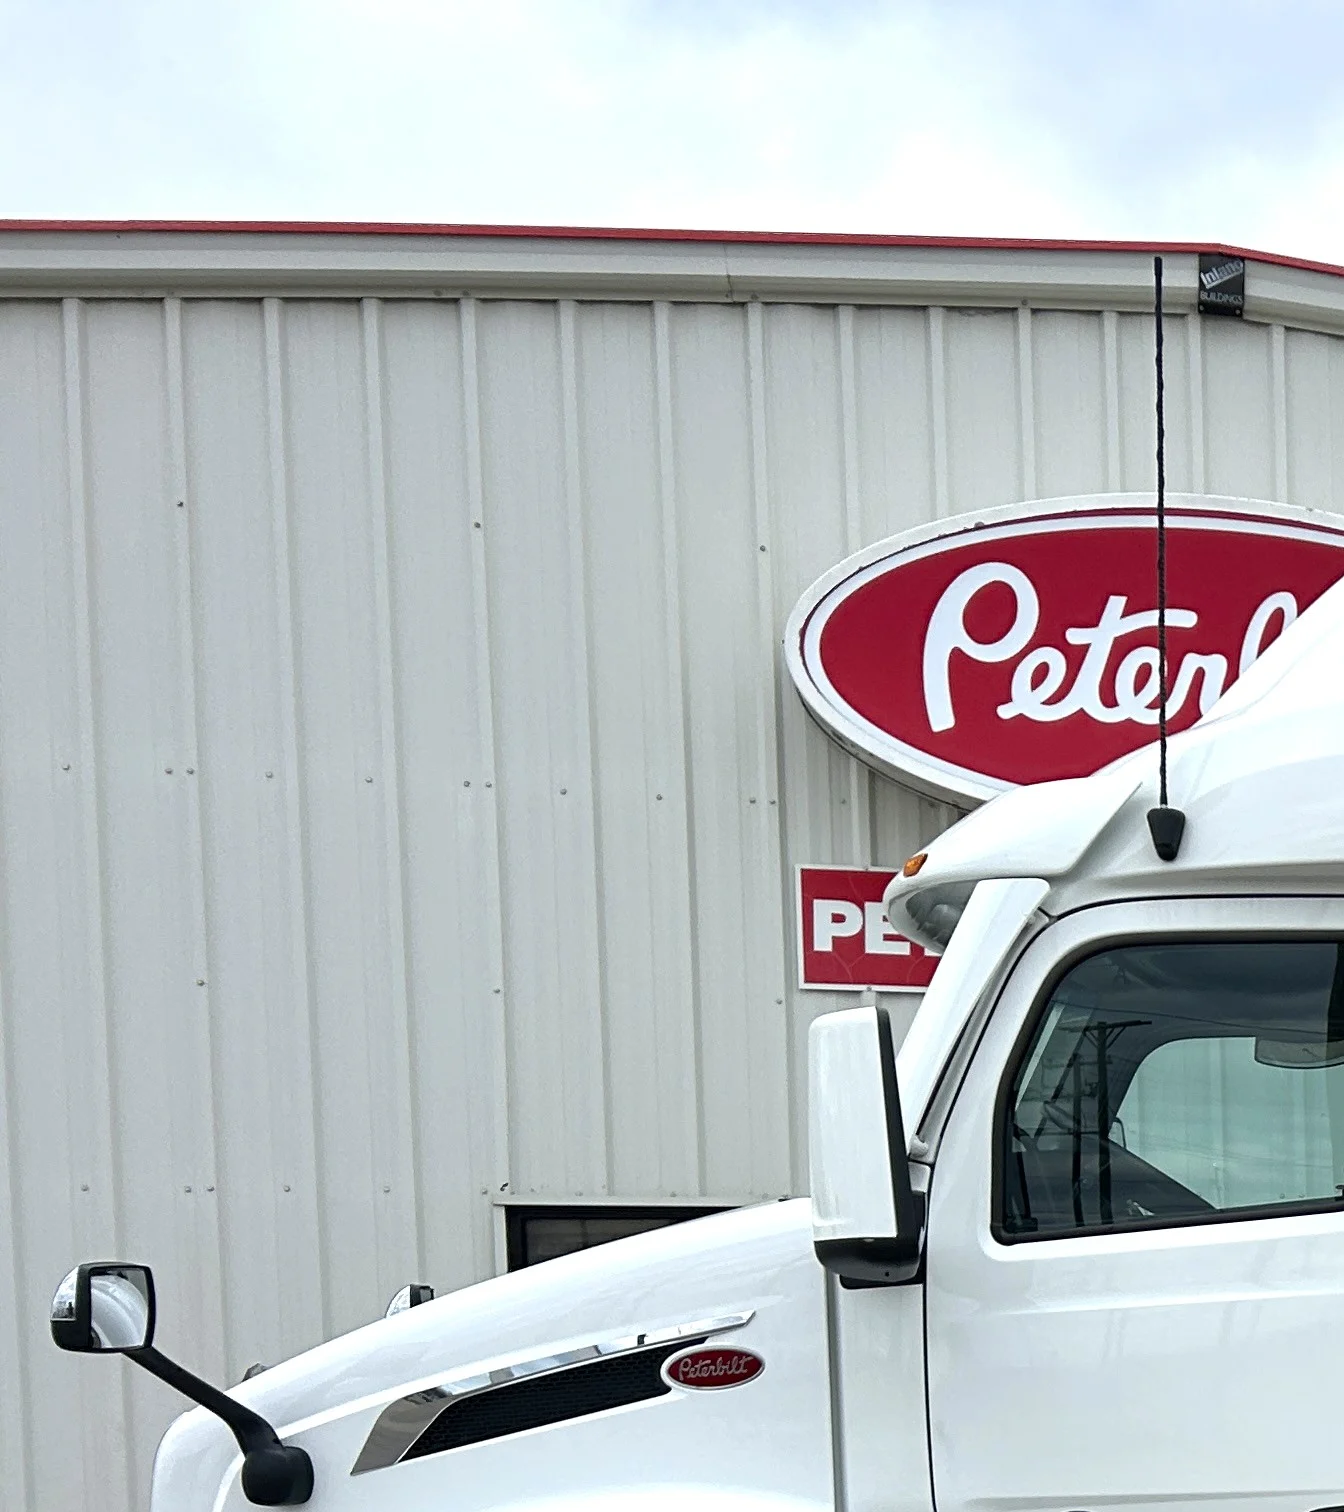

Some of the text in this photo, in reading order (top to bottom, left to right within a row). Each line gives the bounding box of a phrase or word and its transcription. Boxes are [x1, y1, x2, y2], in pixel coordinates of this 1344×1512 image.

[1200, 291, 1243, 305] BUILDINGS
[813, 898, 942, 956] PE
[678, 1356, 754, 1381] Peterbilt
